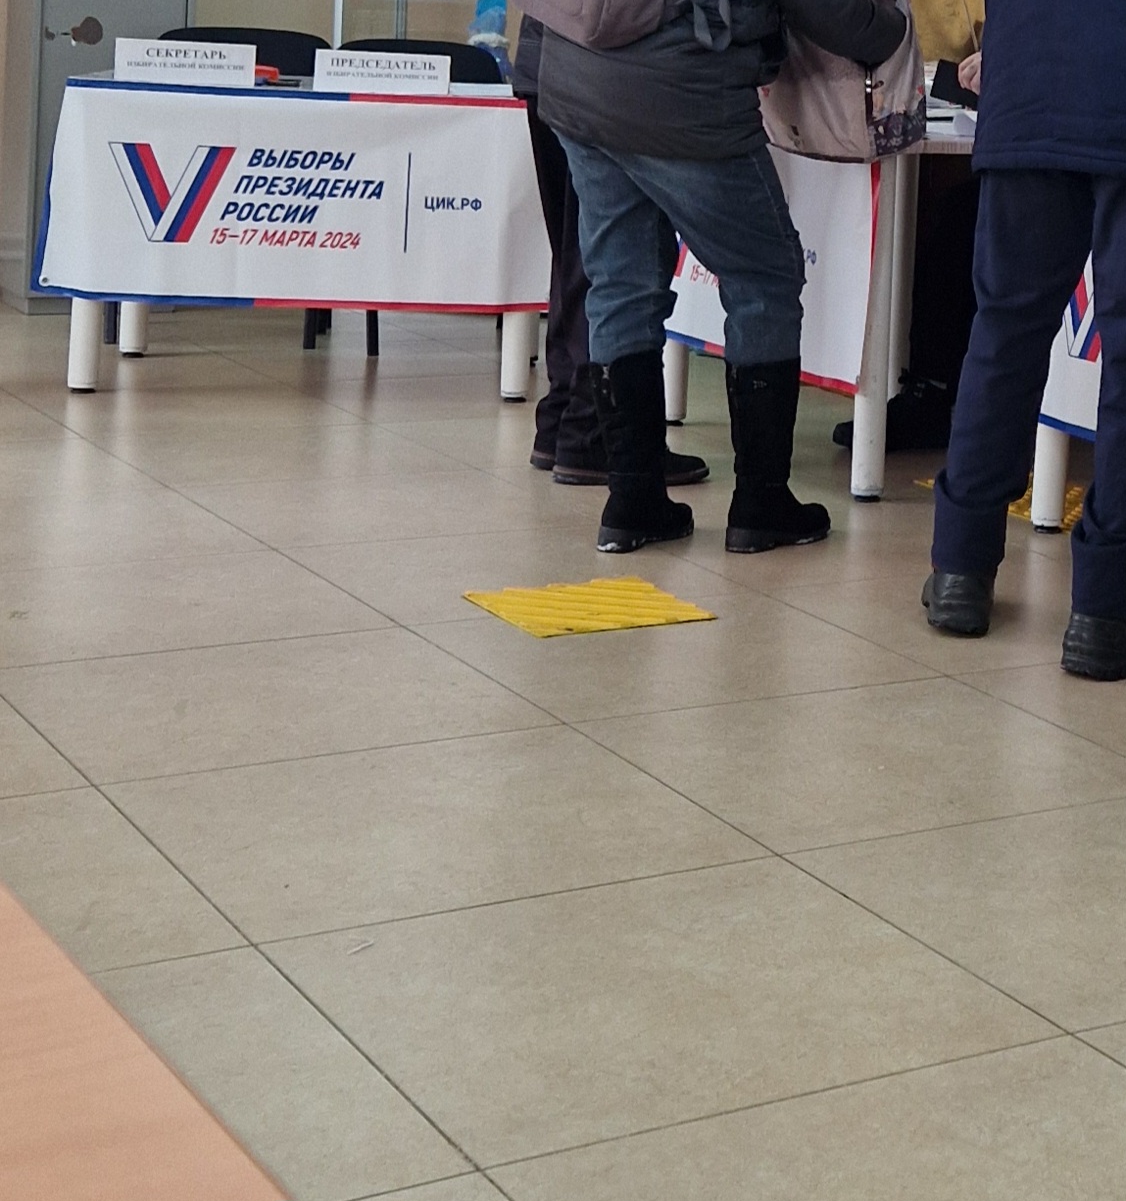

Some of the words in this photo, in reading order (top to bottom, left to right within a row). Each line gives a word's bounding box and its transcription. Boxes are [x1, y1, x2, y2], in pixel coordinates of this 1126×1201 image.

[145, 48, 227, 60] СЕКРЕТАРЬ
[330, 58, 436, 71] ПРЕДСЕДАТЕЛЬ
[247, 148, 356, 171] ВЫБОРЫ
[233, 175, 385, 200] ПРЕЗИДЕНТА
[220, 201, 319, 224] РОССИИ
[424, 196, 482, 212] ЦИК.РФ
[258, 229, 317, 247] МАРТА
[319, 232, 361, 249] 2024
